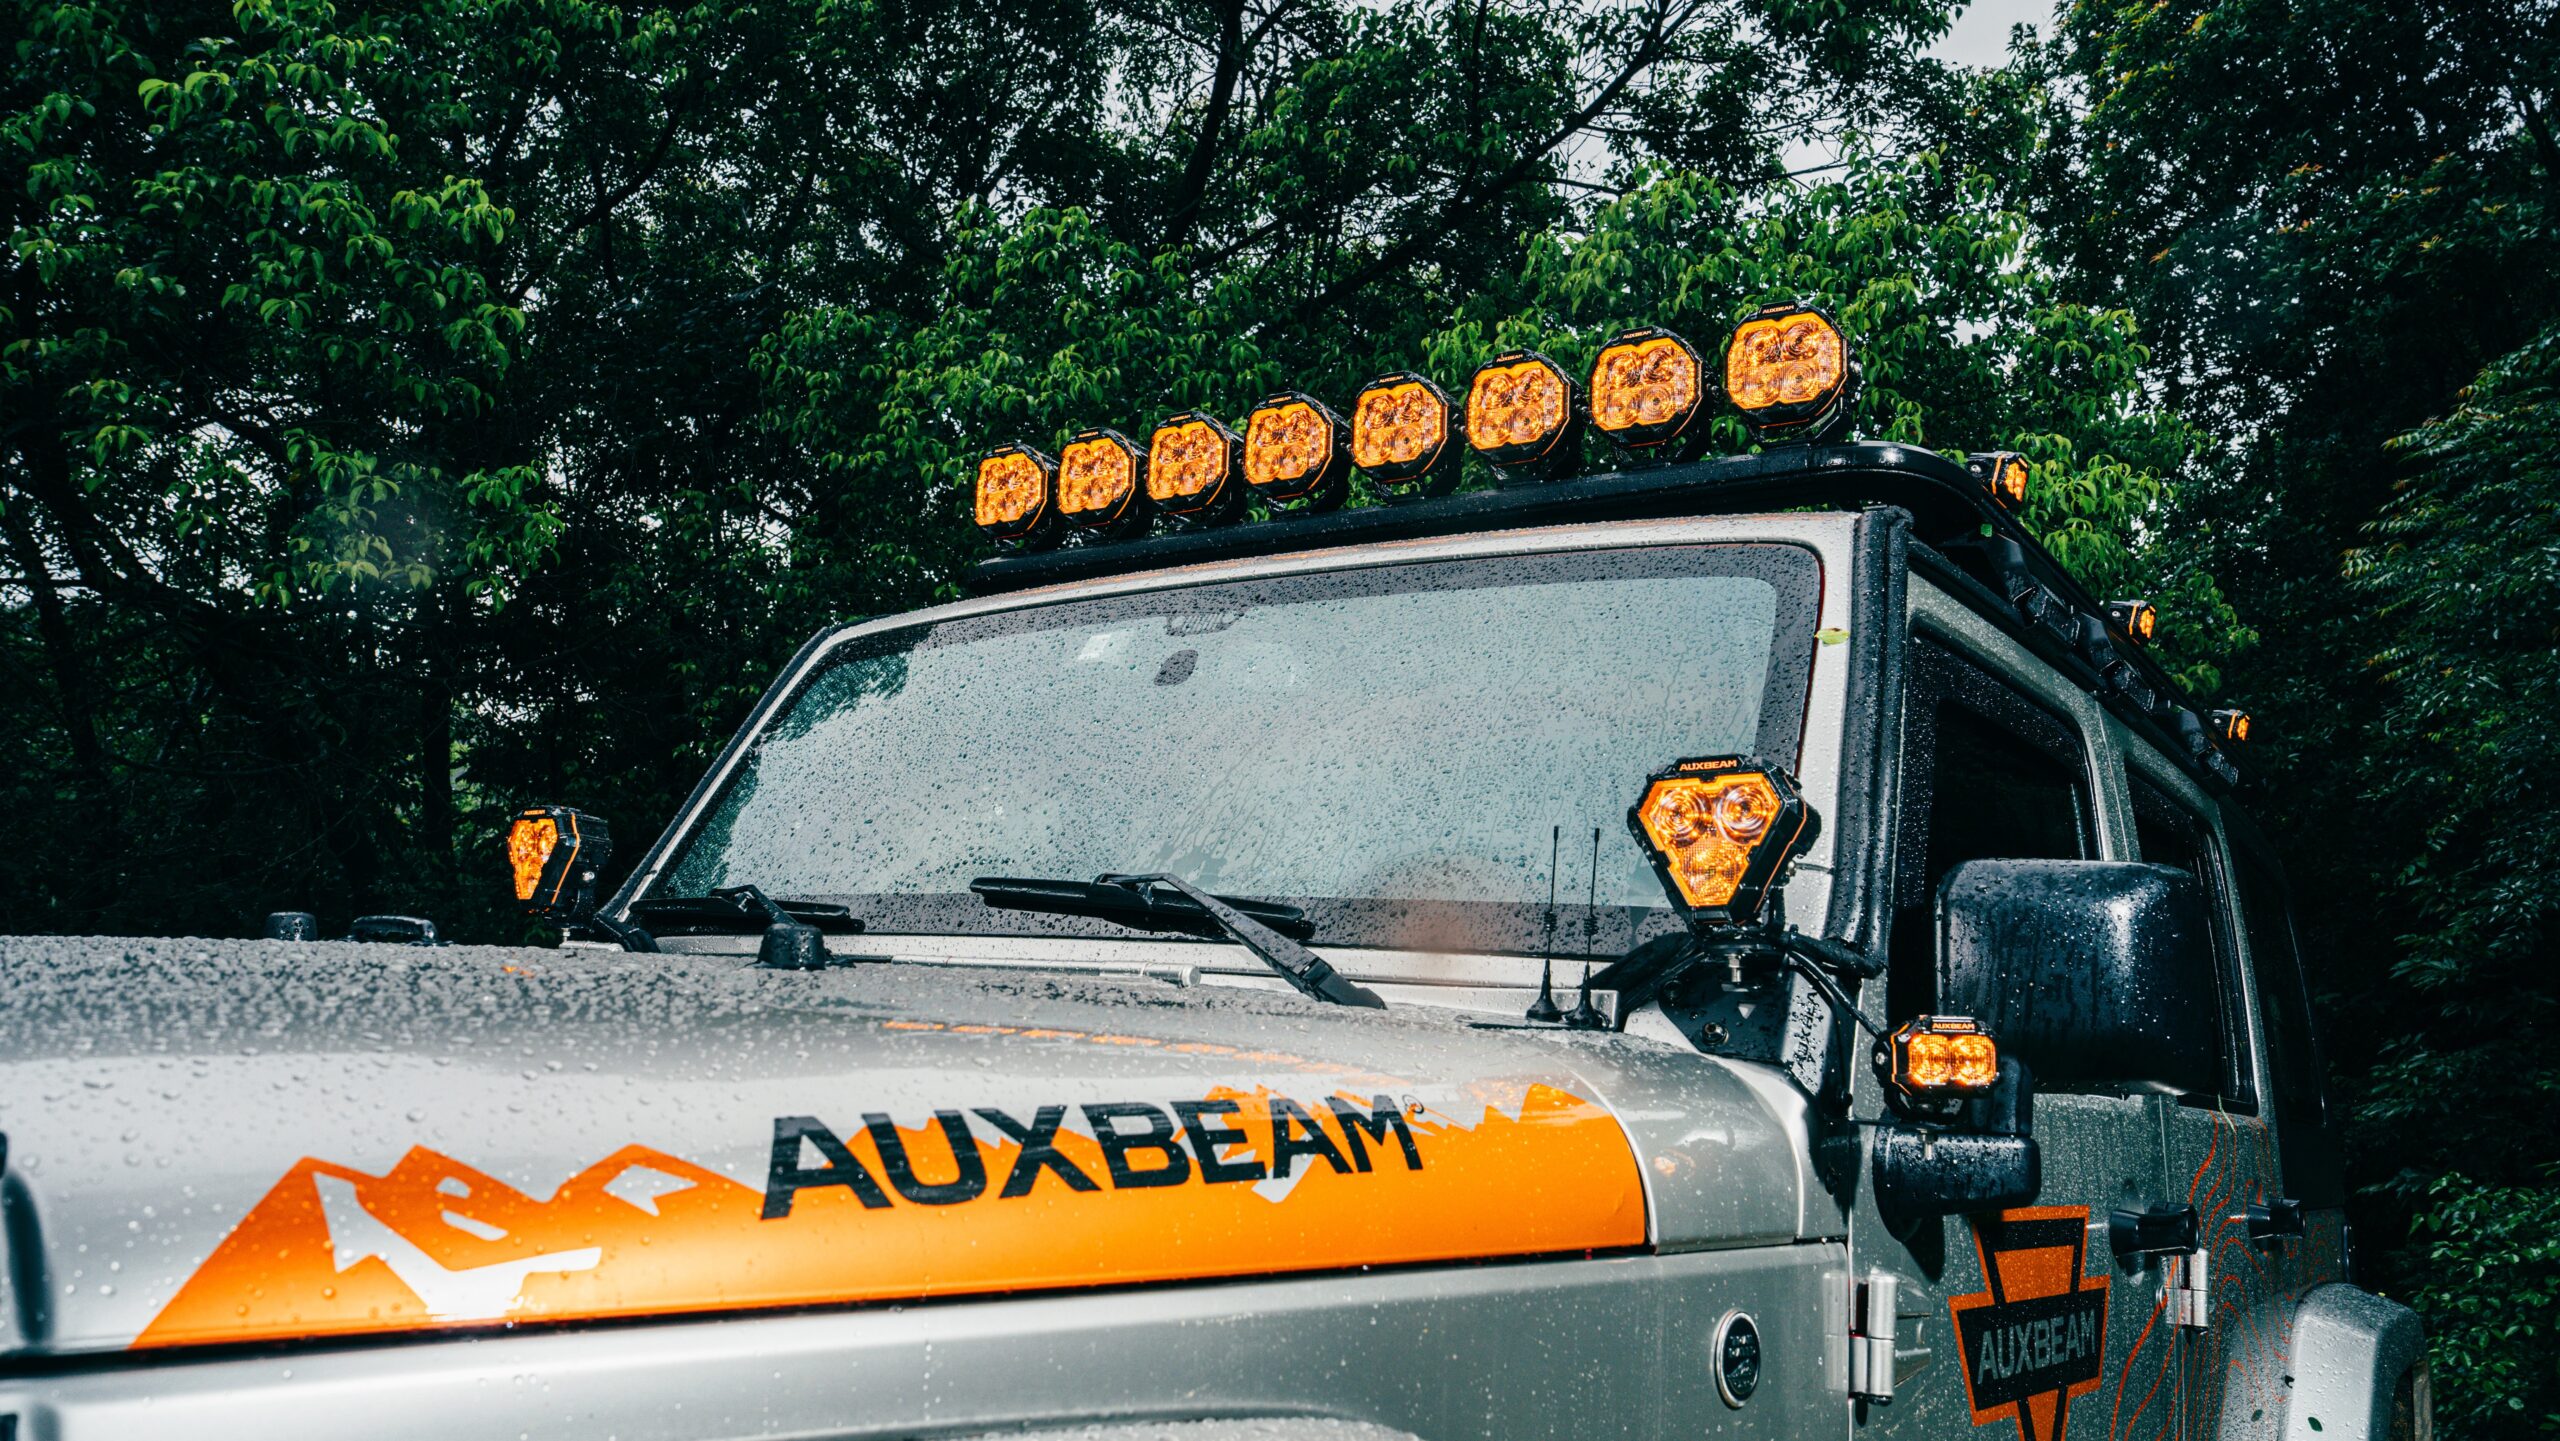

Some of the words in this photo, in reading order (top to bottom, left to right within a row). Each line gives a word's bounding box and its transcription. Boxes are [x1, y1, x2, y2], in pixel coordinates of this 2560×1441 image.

[1762, 305, 1795, 314] AUXBEAM
[1679, 759, 1738, 771] AUXBEAM
[1931, 1022, 1976, 1030] AUXBEAM
[760, 1094, 1424, 1221] AUXBEAM
[1977, 1309, 2096, 1385] AUXBEAM
